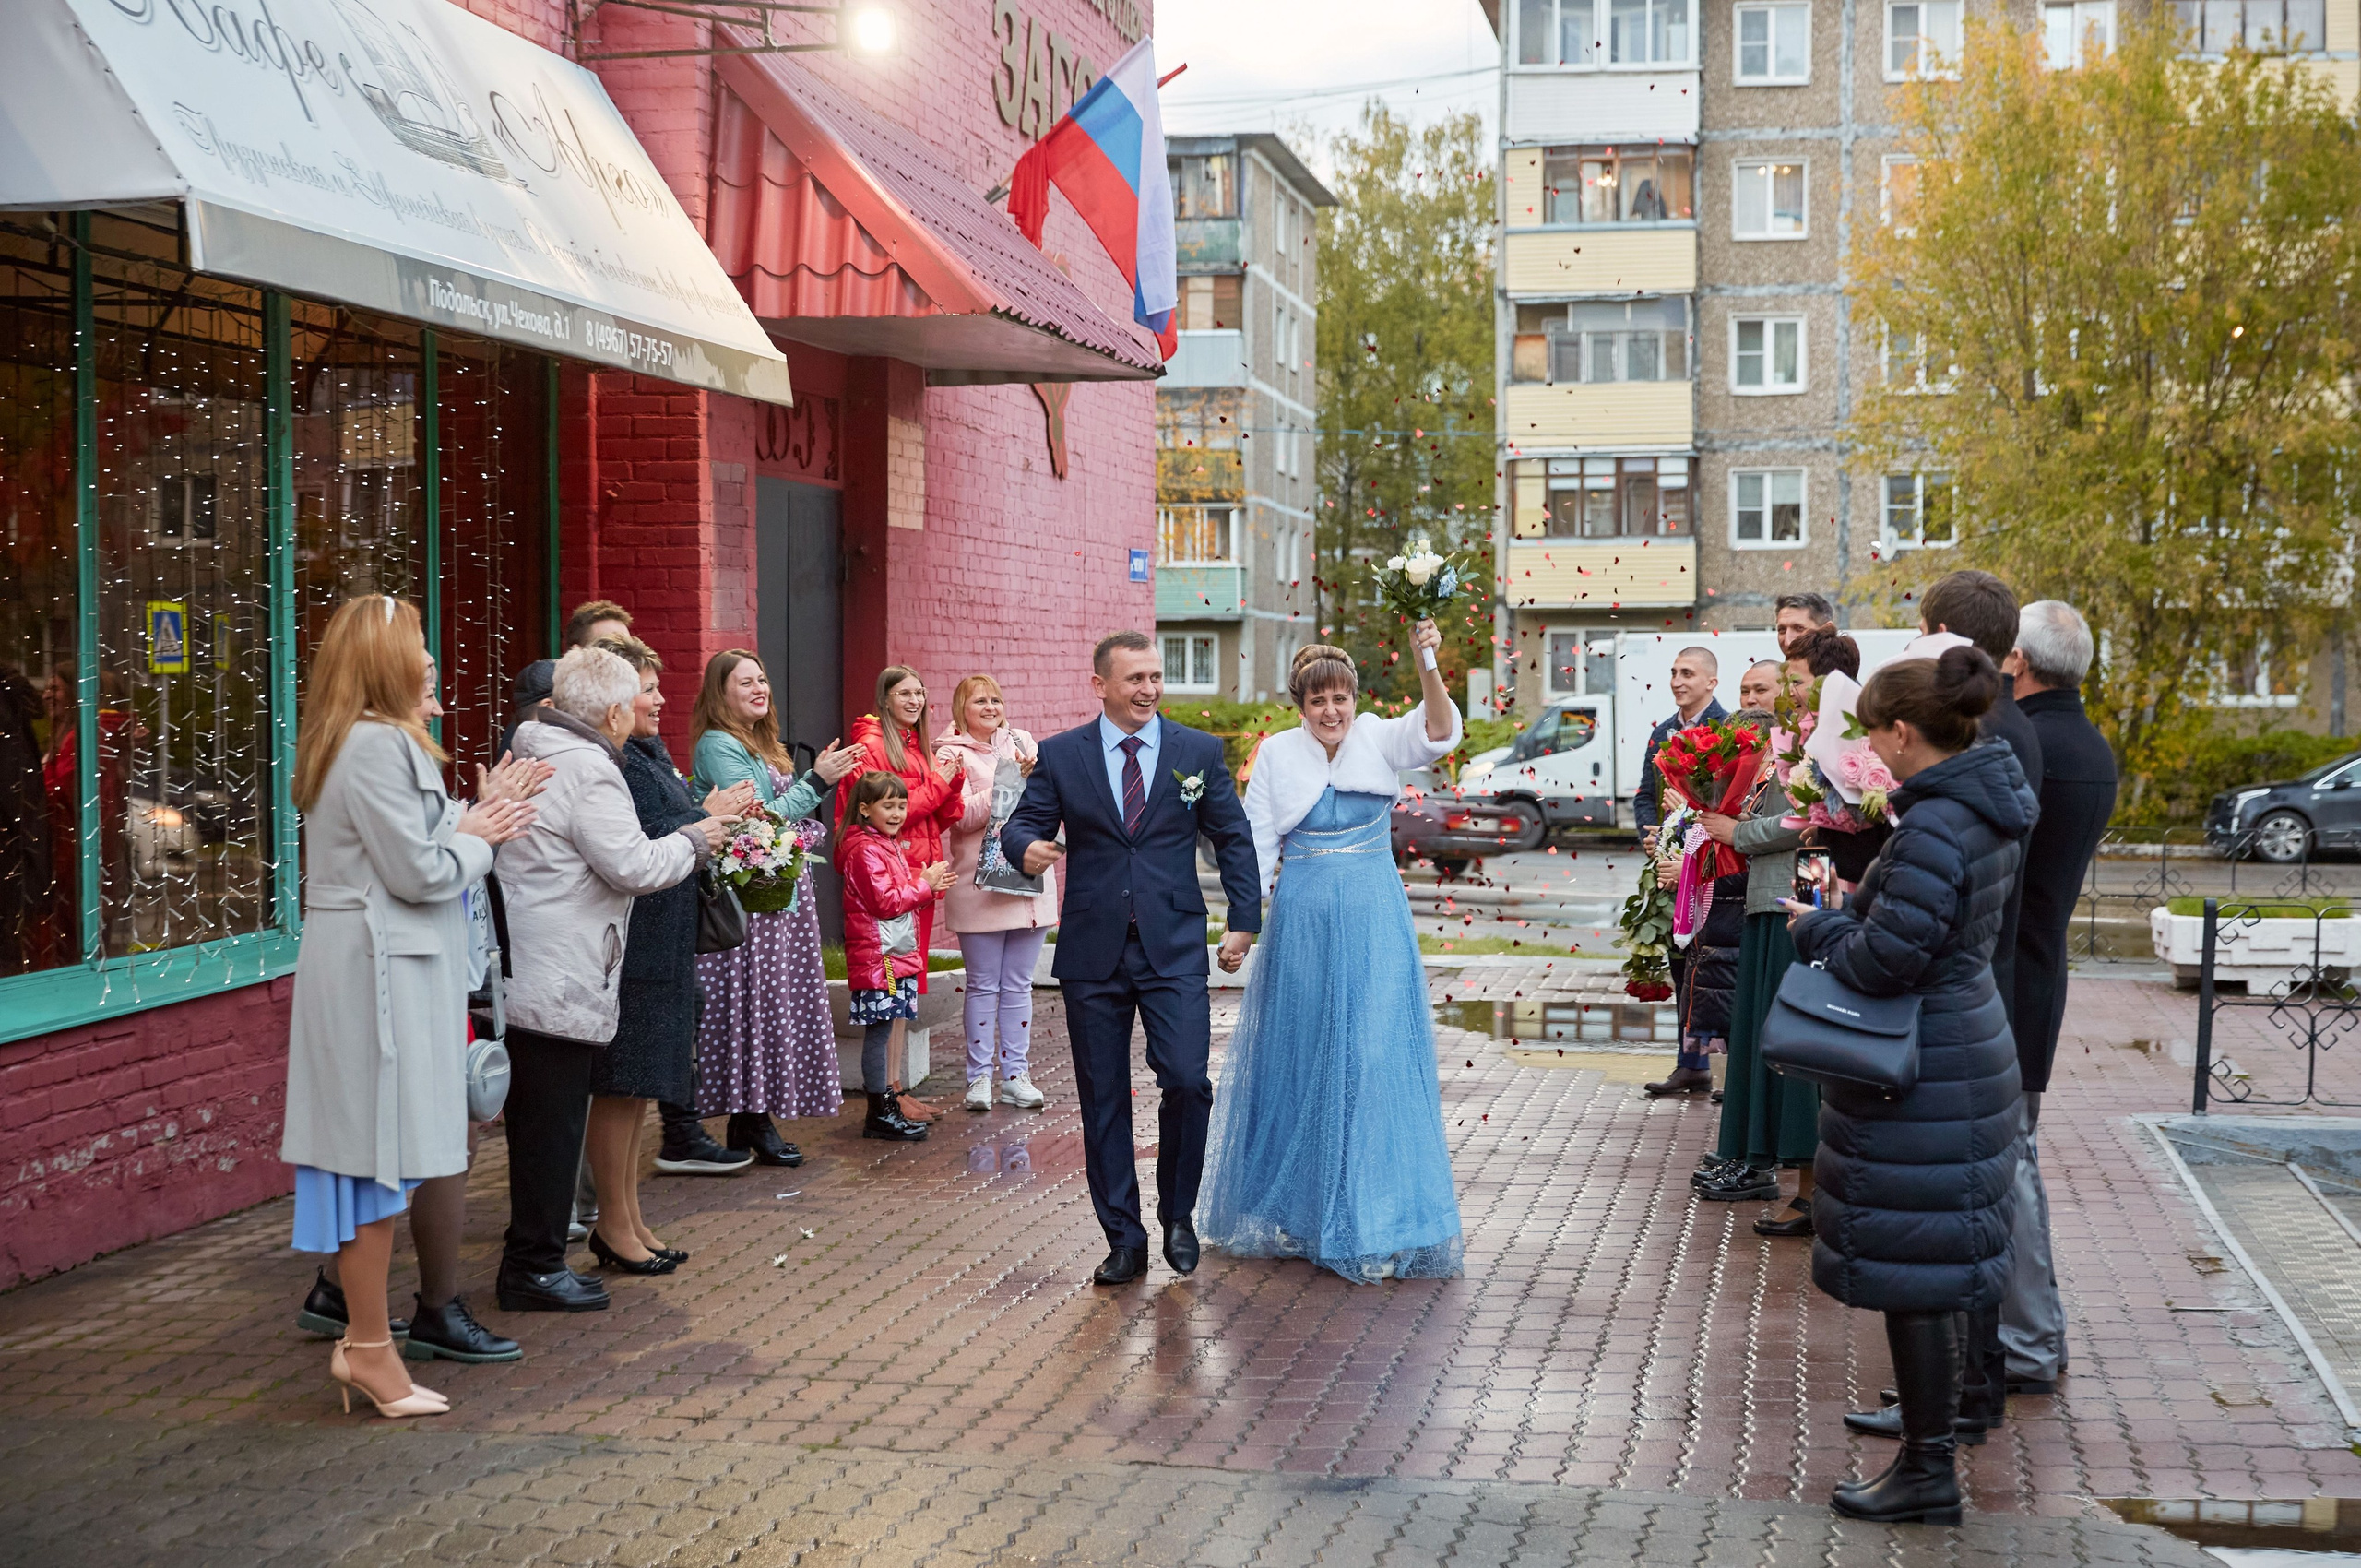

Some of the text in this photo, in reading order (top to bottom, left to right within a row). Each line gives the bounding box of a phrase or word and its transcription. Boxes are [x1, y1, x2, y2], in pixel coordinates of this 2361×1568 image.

[429, 278, 492, 326] Подольск,
[585, 320, 595, 347] 8
[595, 321, 628, 360] (4967)
[629, 332, 673, 367] 57-75-57
